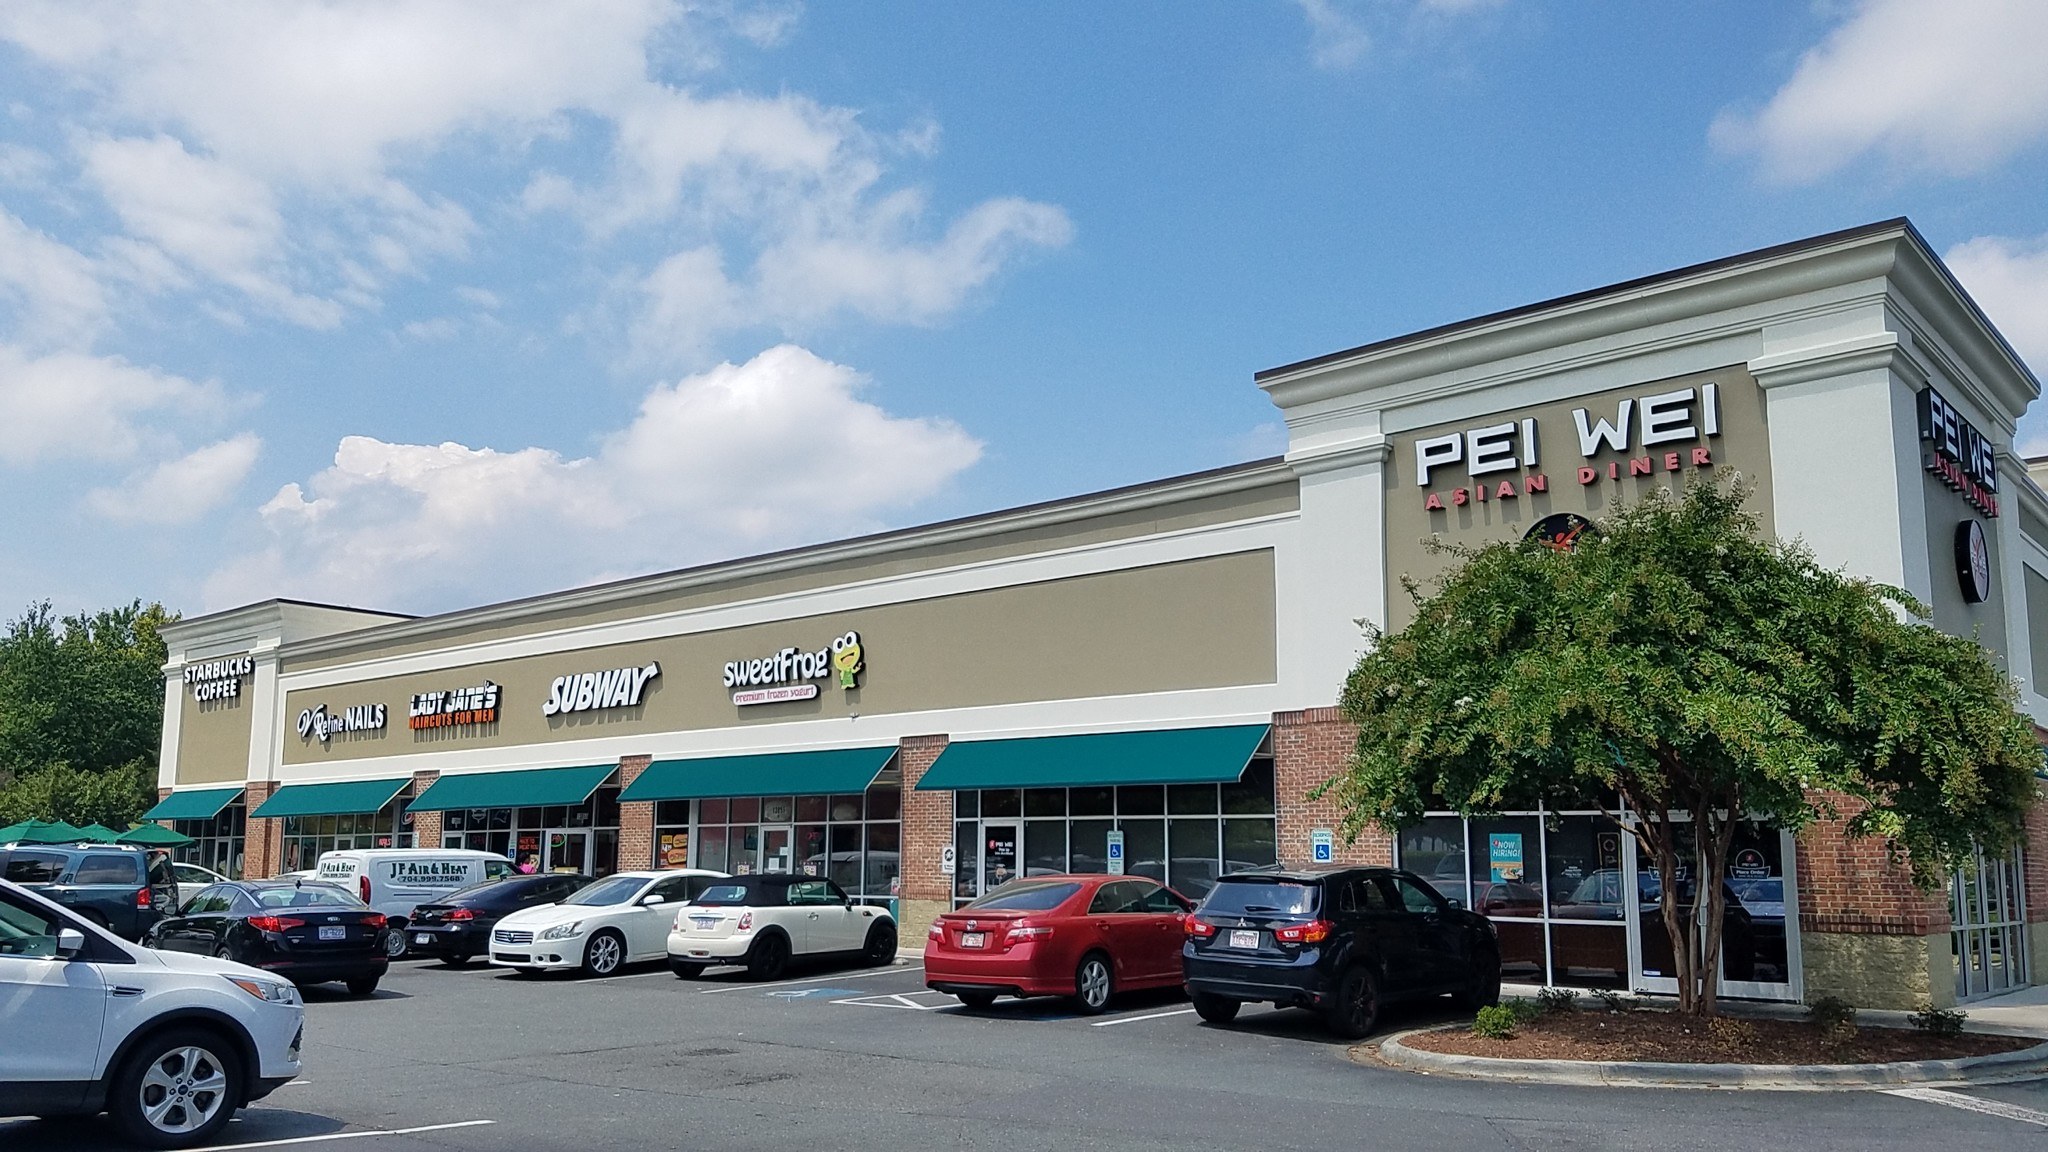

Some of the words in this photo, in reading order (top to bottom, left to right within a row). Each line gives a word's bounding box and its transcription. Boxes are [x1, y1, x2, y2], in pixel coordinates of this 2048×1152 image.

[1414, 417, 1540, 487] PEI
[1571, 382, 1721, 458] WEI
[1929, 388, 1964, 463] PEI
[1425, 473, 1549, 511] ASIAN
[1577, 447, 1713, 486] DINER
[184, 656, 253, 684] STARBUCKS
[723, 647, 829, 688] sweetFrog
[194, 678, 239, 702] COFFEE
[409, 691, 446, 717] LADY
[446, 681, 499, 712] JANE'S
[542, 661, 659, 717] SUBWAY
[735, 691, 765, 703] premium
[767, 689, 789, 700] frozen
[790, 686, 814, 698] yogurt
[345, 703, 386, 731] NAILS
[408, 713, 452, 730] HAIRCUTS
[454, 711, 472, 725] FOR
[473, 708, 494, 723] MEN
[1492, 849, 1521, 857] HIRING!
[1498, 841, 1515, 849] NOW
